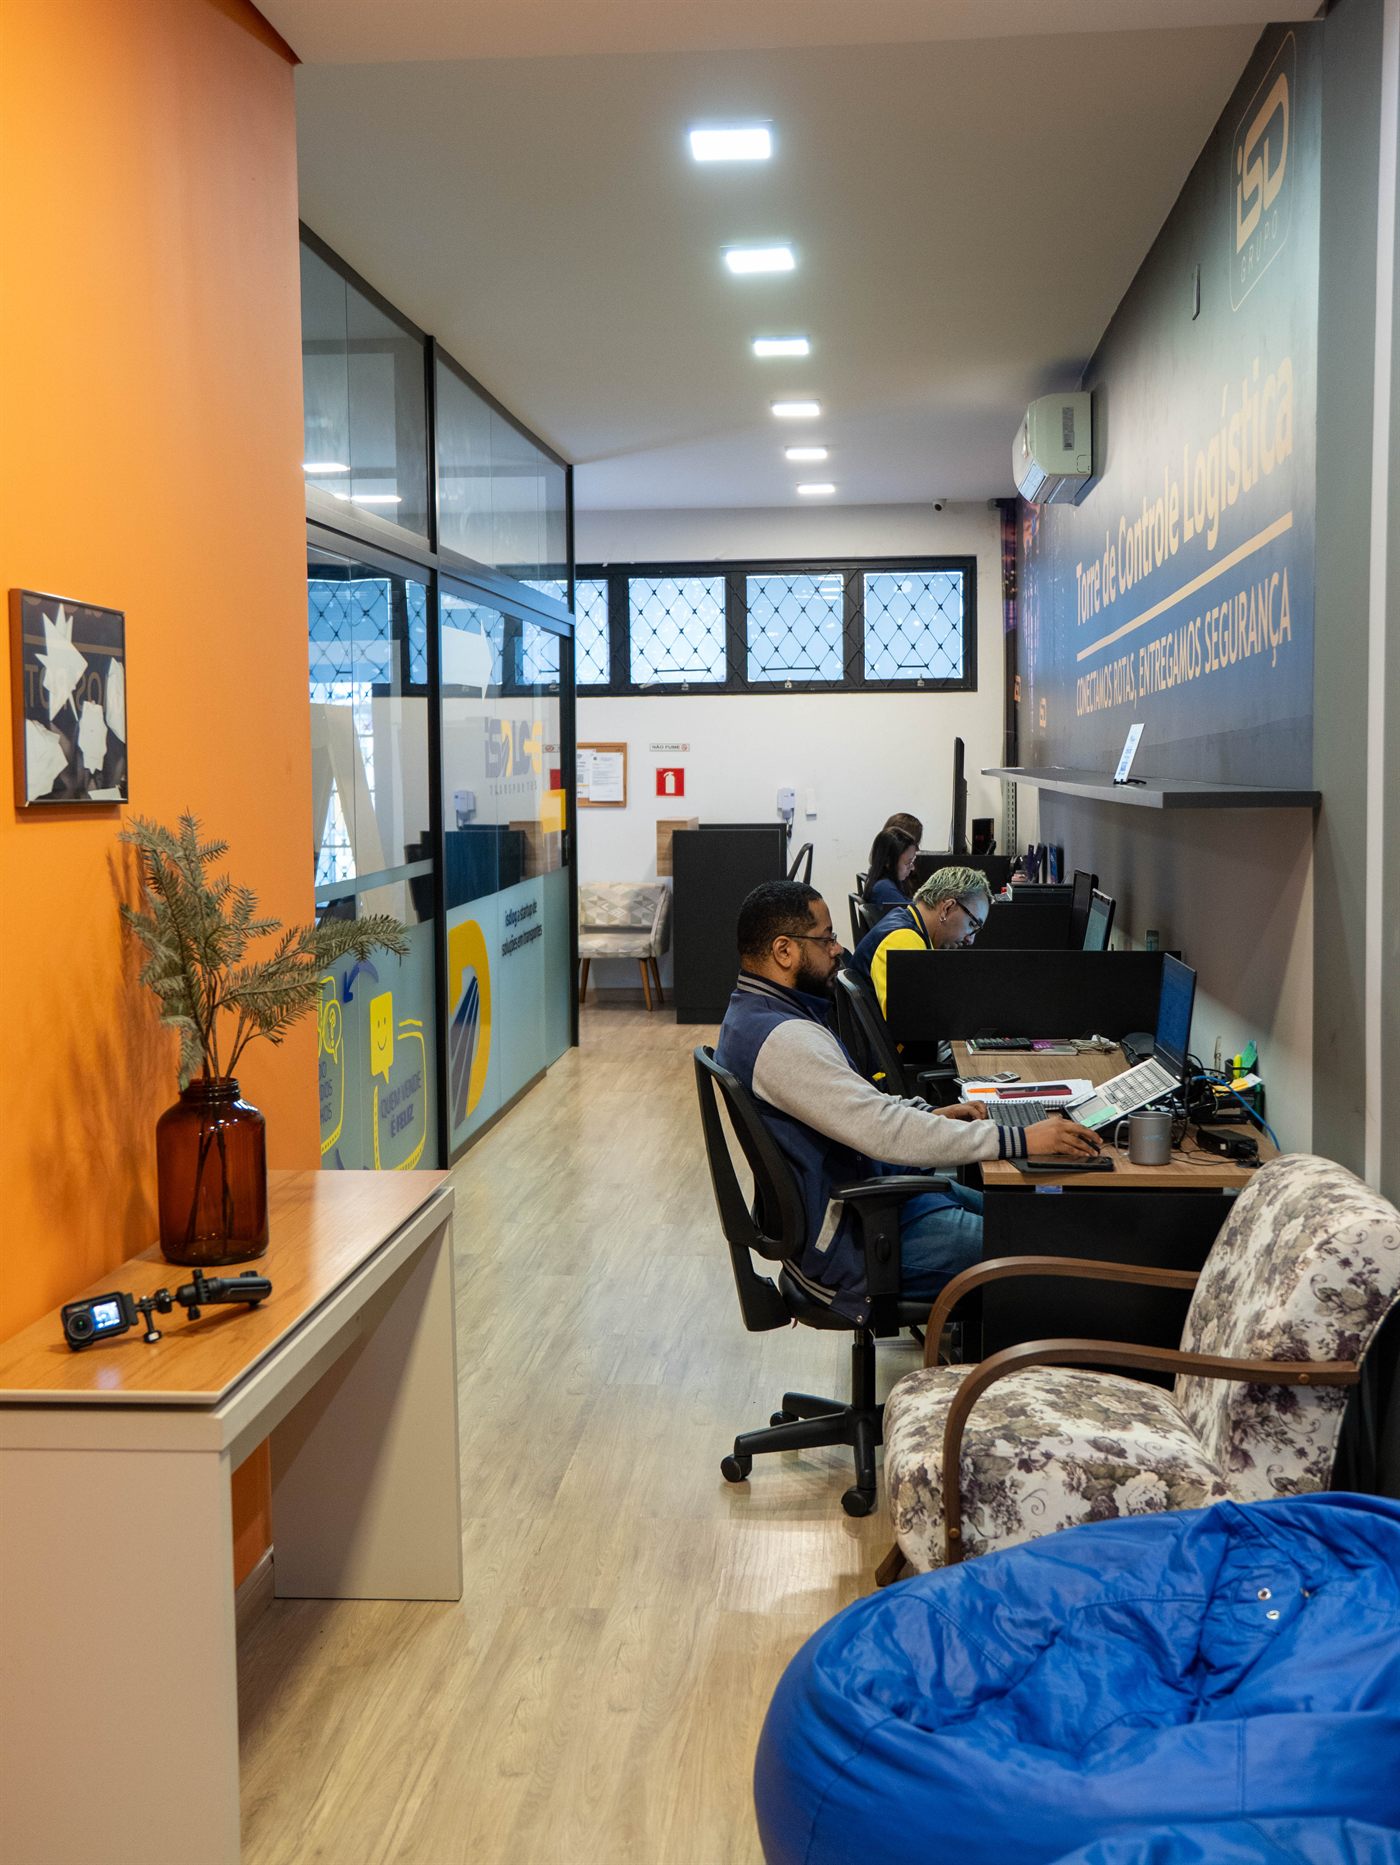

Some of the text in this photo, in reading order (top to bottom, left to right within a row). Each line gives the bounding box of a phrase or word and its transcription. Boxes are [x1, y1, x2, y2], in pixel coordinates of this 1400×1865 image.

[1240, 209, 1279, 284] GRUPO
[1076, 562, 1100, 627] Torre
[1102, 530, 1117, 609] de
[1118, 464, 1180, 595] Controle
[1184, 356, 1294, 551] Logística
[1076, 663, 1112, 717] CONECTAMOS
[1113, 652, 1137, 710] ROTAS,
[1139, 616, 1201, 697] ENTREGAMOS
[1204, 566, 1292, 668] SEGURANÇA
